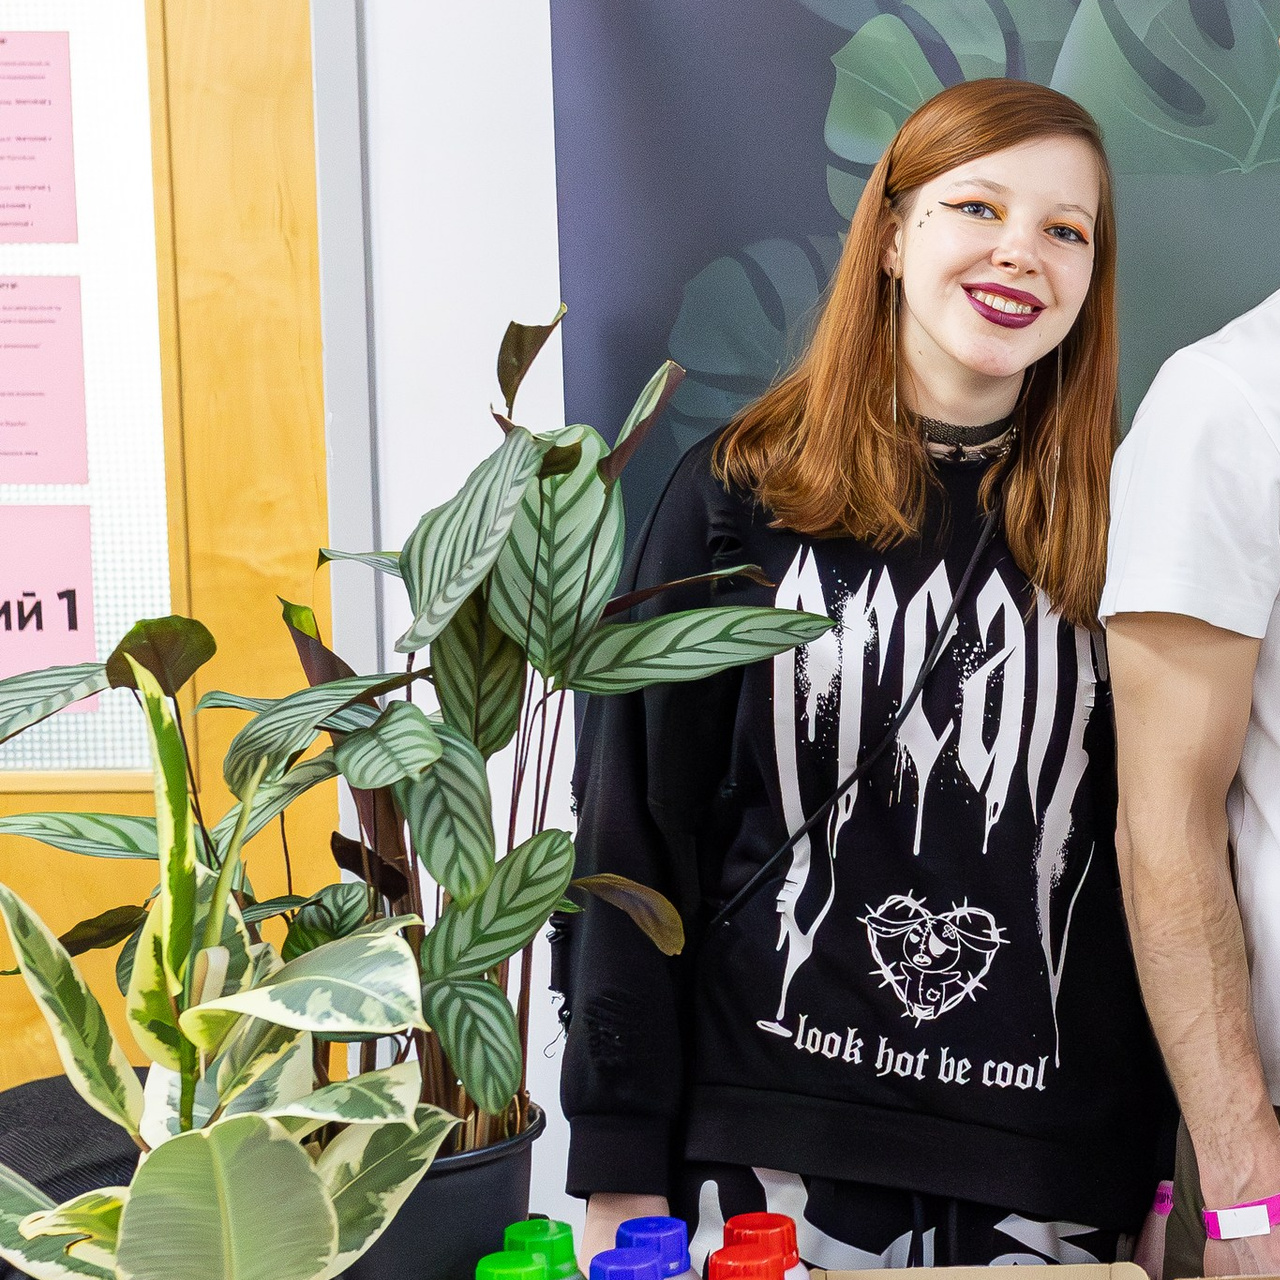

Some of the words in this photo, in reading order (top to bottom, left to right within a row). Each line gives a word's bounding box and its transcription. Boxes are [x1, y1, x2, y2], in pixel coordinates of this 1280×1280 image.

[57, 588, 78, 632] 1
[794, 1013, 864, 1065] look
[874, 1034, 930, 1078] hot
[937, 1046, 972, 1085] be
[982, 1055, 1050, 1092] cool
